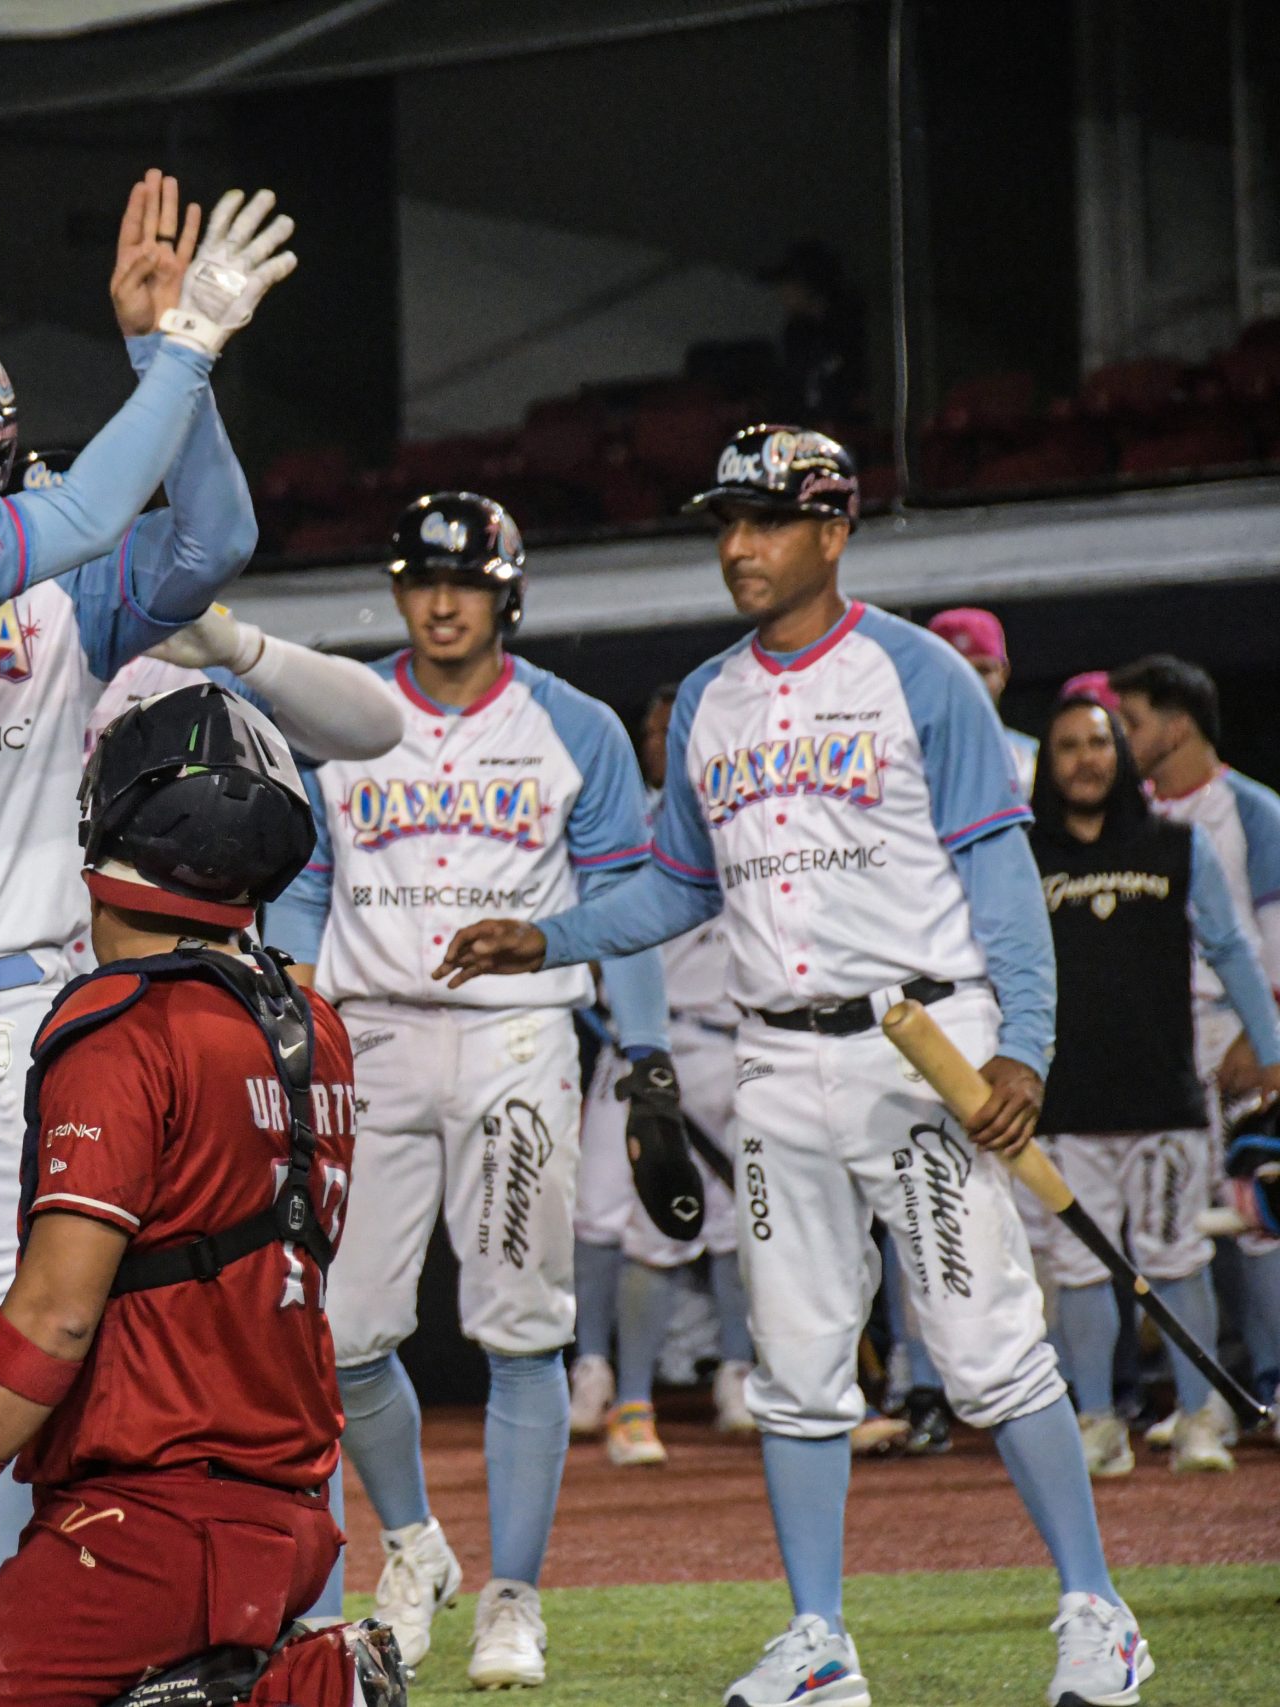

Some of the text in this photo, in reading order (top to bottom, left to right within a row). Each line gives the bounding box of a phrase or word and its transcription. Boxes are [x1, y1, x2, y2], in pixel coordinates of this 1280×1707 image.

[348, 778, 546, 853] OAXACA
[703, 730, 883, 830] OAXACA
[378, 883, 538, 909] INTERCERAMIC
[733, 847, 887, 886] INTERCERAMIC
[478, 1138, 501, 1257] caliente.mx
[499, 1097, 554, 1271] Caliente
[746, 1162, 774, 1241] G500
[909, 1117, 974, 1299] Caliente
